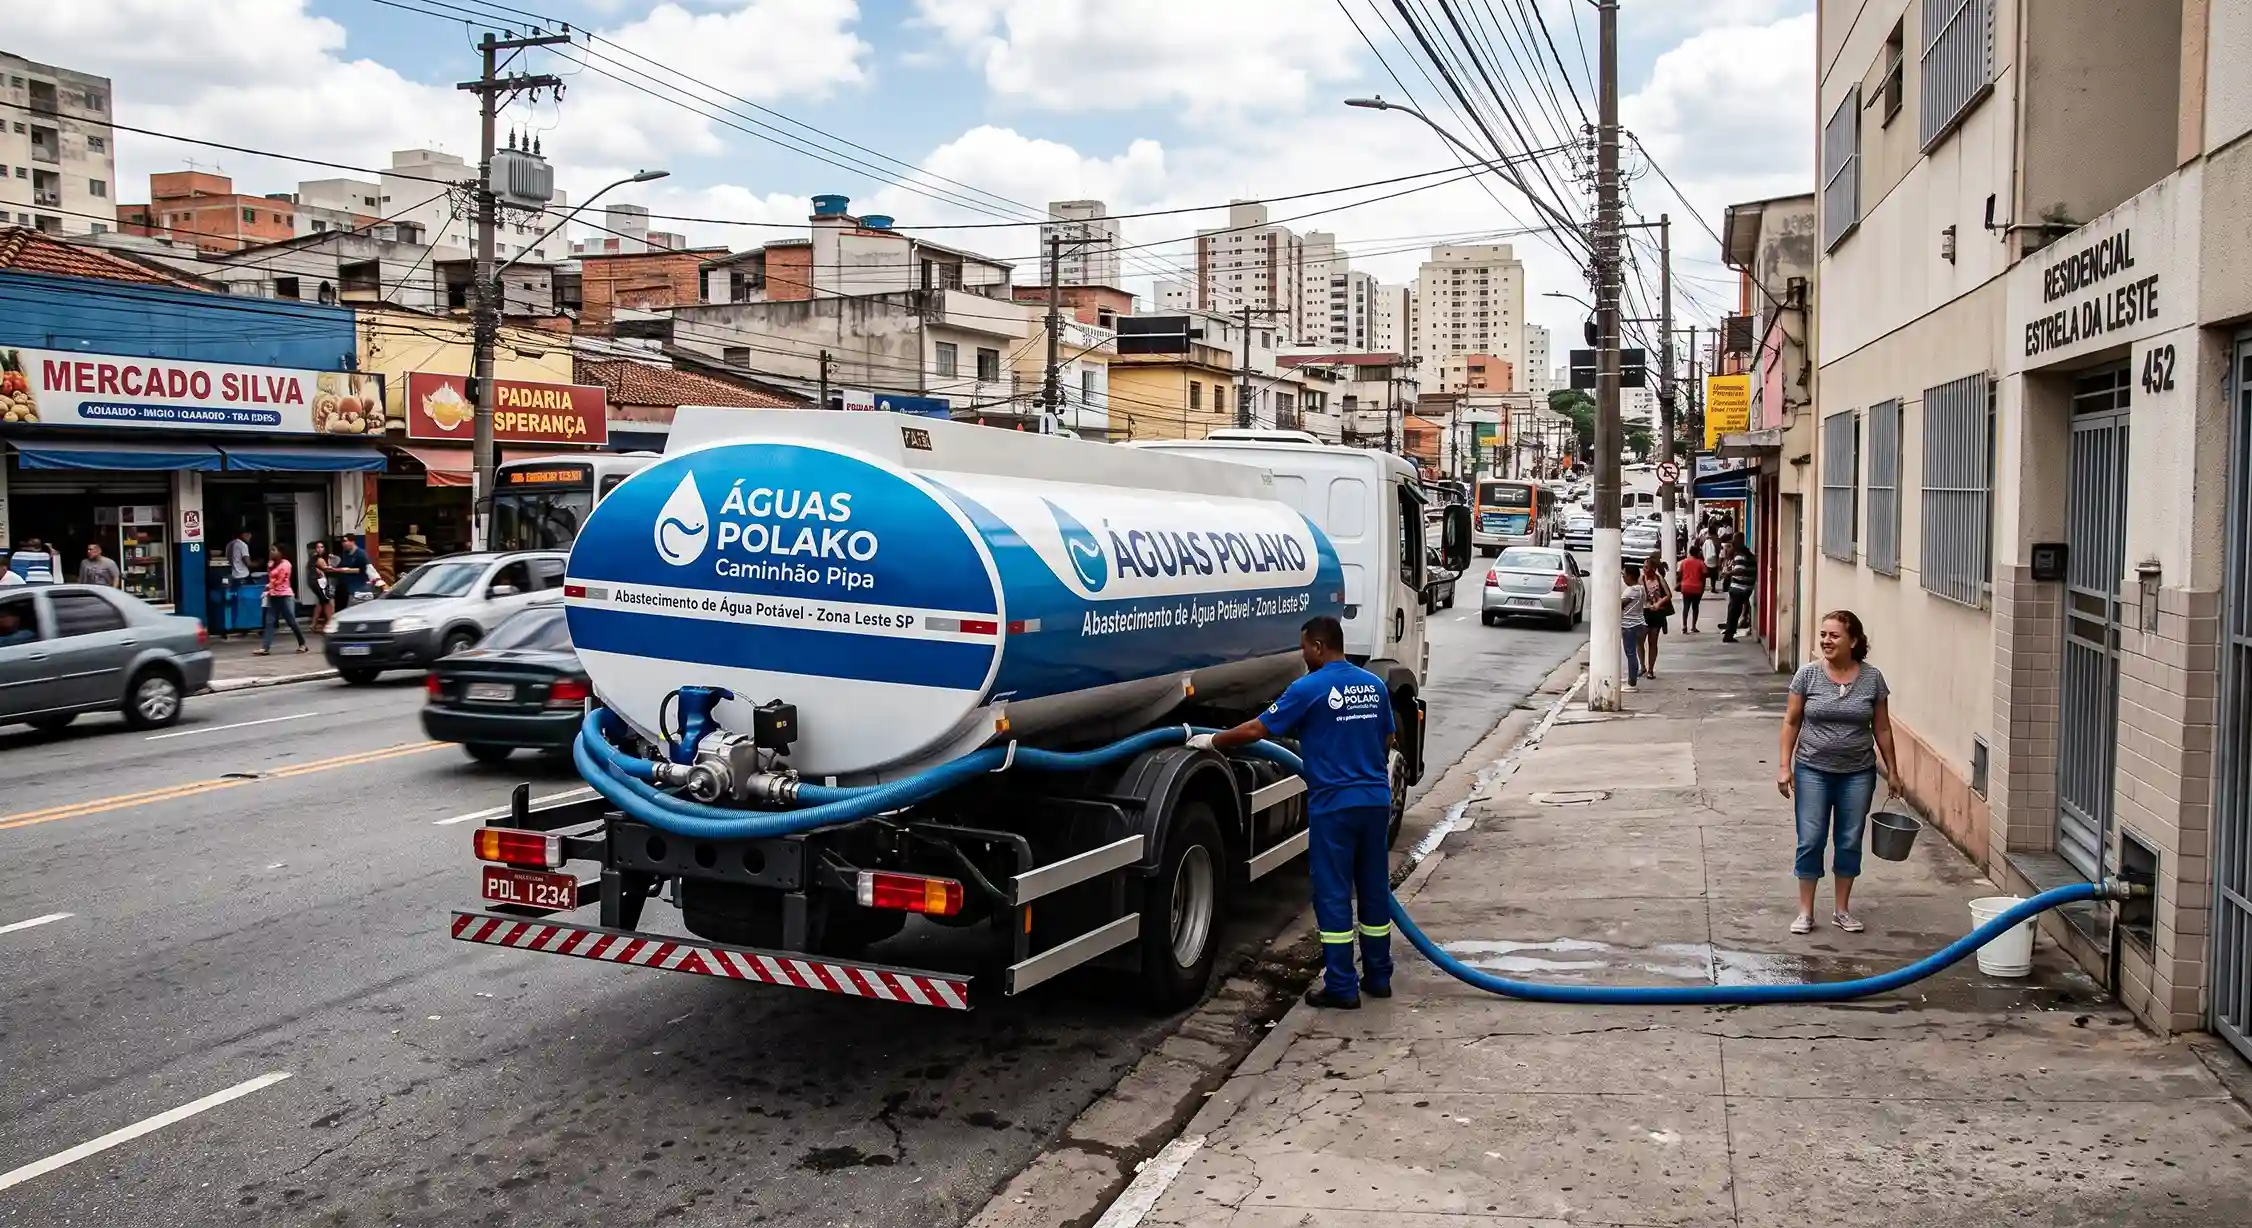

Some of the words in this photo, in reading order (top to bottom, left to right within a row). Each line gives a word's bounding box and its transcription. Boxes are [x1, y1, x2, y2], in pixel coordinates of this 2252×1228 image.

[2044, 228, 2135, 303] RESIDENCIAL
[2025, 306, 2080, 356] ESTRELA
[2082, 297, 2102, 338] DA
[2106, 273, 2159, 332] LESTE
[43, 359, 212, 400] MERCADO
[221, 372, 304, 405] SILVA
[2142, 344, 2175, 394] 452
[498, 386, 573, 410] PADARIA
[494, 412, 587, 439] SPERANÇA
[720, 478, 852, 522] ÁGUAS
[717, 521, 878, 561] POLAKO
[1208, 532, 1306, 575] POLAKO
[715, 558, 820, 584] Caminhão
[827, 567, 874, 591] Pipa
[615, 589, 698, 610] Abastecimento
[701, 599, 717, 611] de
[720, 596, 752, 618] Água
[756, 600, 804, 620] Potável
[816, 608, 850, 624] Zona
[855, 611, 892, 628] Leste
[895, 614, 915, 629] SP
[1081, 606, 1172, 637] Abastecimento
[1175, 603, 1188, 626] de
[1190, 597, 1215, 629] Água
[1217, 598, 1250, 620] Potável
[1256, 597, 1277, 616] Zona
[1278, 595, 1298, 614] Leste
[1299, 593, 1310, 612] SP
[1344, 694, 1380, 704] POLAKO
[488, 878, 521, 900] PDL
[528, 883, 570, 907] 1234
